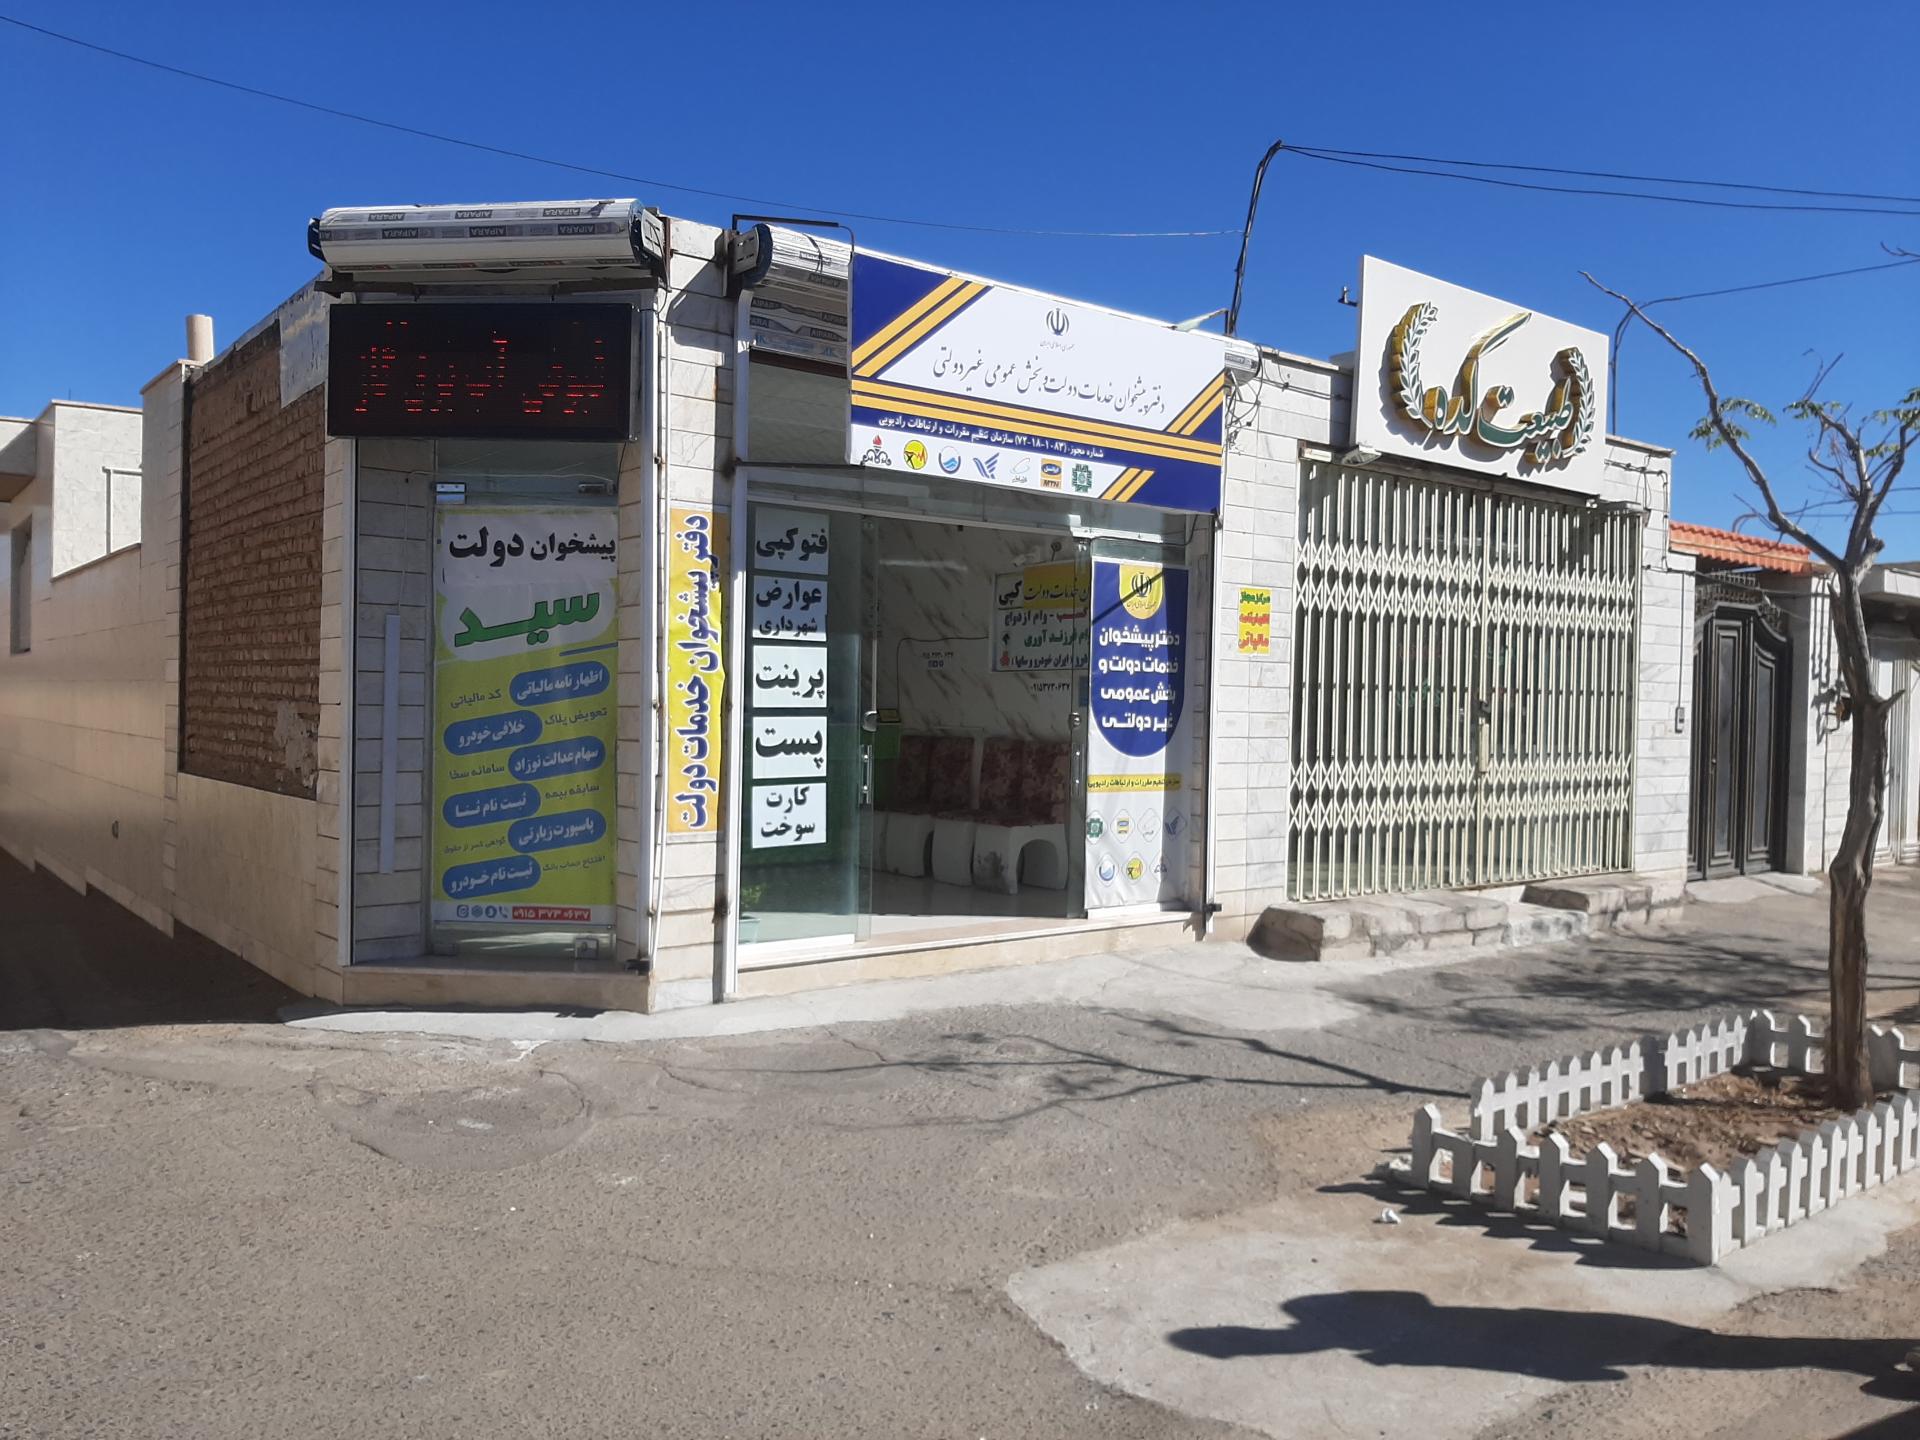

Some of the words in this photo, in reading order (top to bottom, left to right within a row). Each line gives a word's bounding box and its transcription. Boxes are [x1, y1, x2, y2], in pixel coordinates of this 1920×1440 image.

[985, 363, 1016, 387] عمومی
[1017, 355, 1042, 393] بخش
[1044, 376, 1077, 396] دولت
[1078, 382, 1114, 403] خدمات
[1114, 376, 1148, 415] پیشخوان
[879, 416, 906, 428] رادیویی
[908, 419, 938, 432] ارتباطات
[945, 425, 970, 438] مقررات
[971, 429, 988, 443] تنظیم
[991, 432, 1014, 444] سازمان
[1087, 448, 1104, 458] شماره
[449, 526, 524, 567] دولت
[530, 533, 616, 562] پیشخوان
[676, 515, 719, 568] دفتر
[756, 580, 822, 610] عوارض
[677, 571, 719, 672] پیشخوان
[759, 616, 818, 637] شهرداری
[1005, 610, 1030, 626] ازدواج
[1100, 625, 1154, 652] پیشخوان
[1155, 630, 1180, 648] دفتر
[1098, 658, 1107, 674] و
[1109, 656, 1140, 675] دولت
[1143, 657, 1178, 674] خدمات
[516, 677, 555, 700] مالیاتی
[555, 675, 573, 689] نامه
[574, 668, 603, 690] اظهار
[756, 664, 825, 699] پرینت
[450, 692, 486, 709] مالیاتی
[488, 689, 502, 699] کد
[1100, 687, 1150, 703] عمومی
[1151, 682, 1176, 704] بخش
[544, 714, 569, 726] پلاک
[569, 707, 608, 723] تعویض
[677, 676, 708, 760] خدمات
[1102, 713, 1151, 731] دولتی
[1153, 712, 1172, 732] غیر
[458, 726, 491, 748] خودرو
[492, 718, 525, 741] خلافی
[574, 746, 599, 765] سهام
[756, 728, 824, 769] پست
[472, 764, 504, 776] سامانه
[514, 758, 542, 775] نوزاد
[544, 753, 576, 768] عدالت
[546, 789, 568, 800] بیمه
[569, 783, 600, 797] سابقه
[675, 764, 716, 827] دولت
[766, 786, 810, 813] کارت
[483, 798, 498, 817] نام
[500, 792, 527, 809] ثبت
[518, 823, 554, 845] زیارتی
[554, 816, 594, 838] پاسپورت
[761, 816, 816, 842] سوخت
[491, 866, 507, 886] نام
[507, 861, 533, 879] ثبت
[451, 871, 490, 893] خودرو
